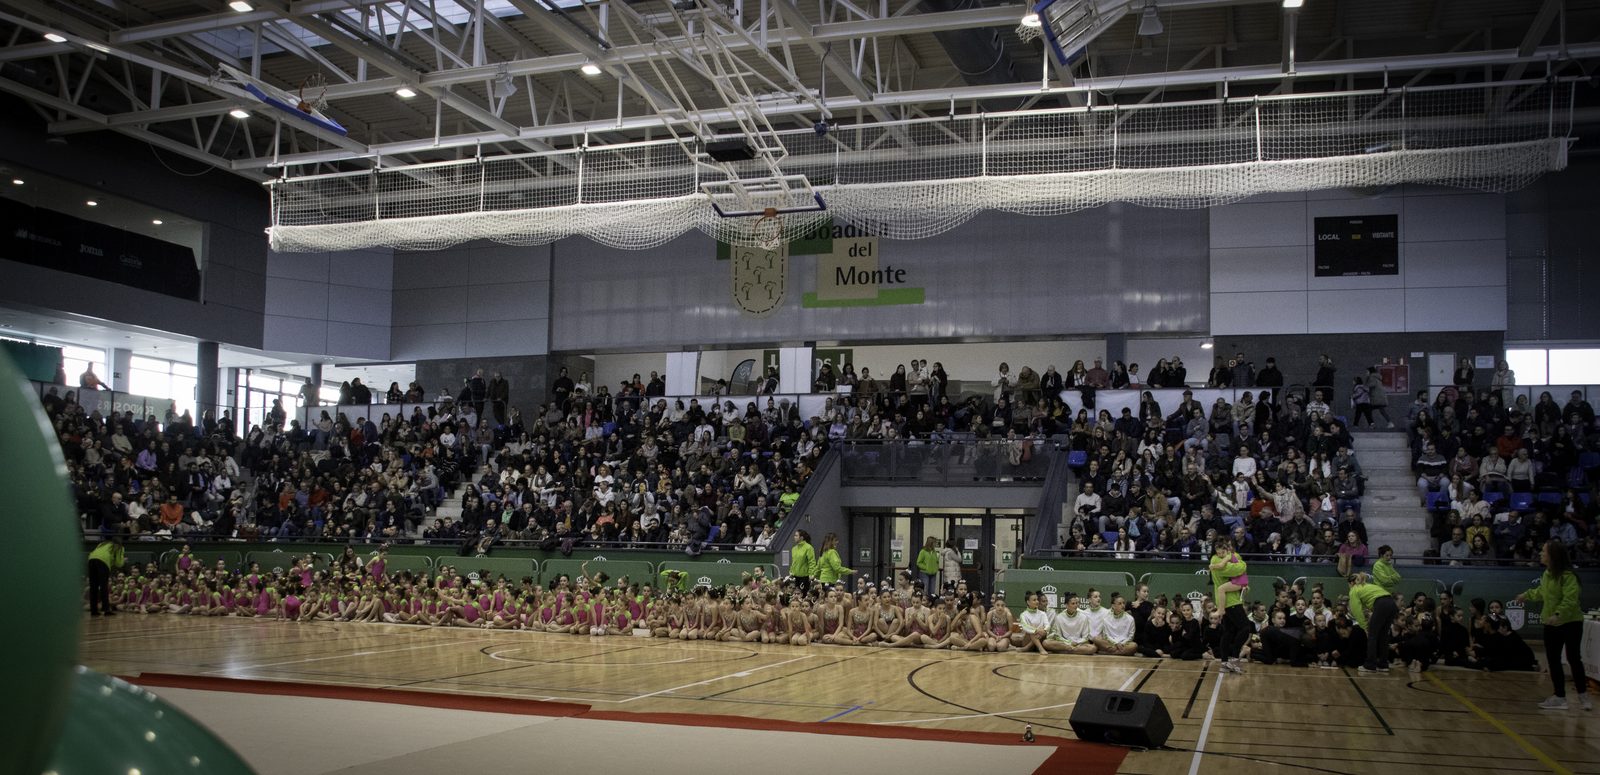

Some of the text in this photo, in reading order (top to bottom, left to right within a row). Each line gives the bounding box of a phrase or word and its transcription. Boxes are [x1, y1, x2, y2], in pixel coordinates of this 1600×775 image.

[1318, 233, 1340, 241] LOCAL
[848, 242, 872, 258] del
[835, 265, 907, 286] Monte
